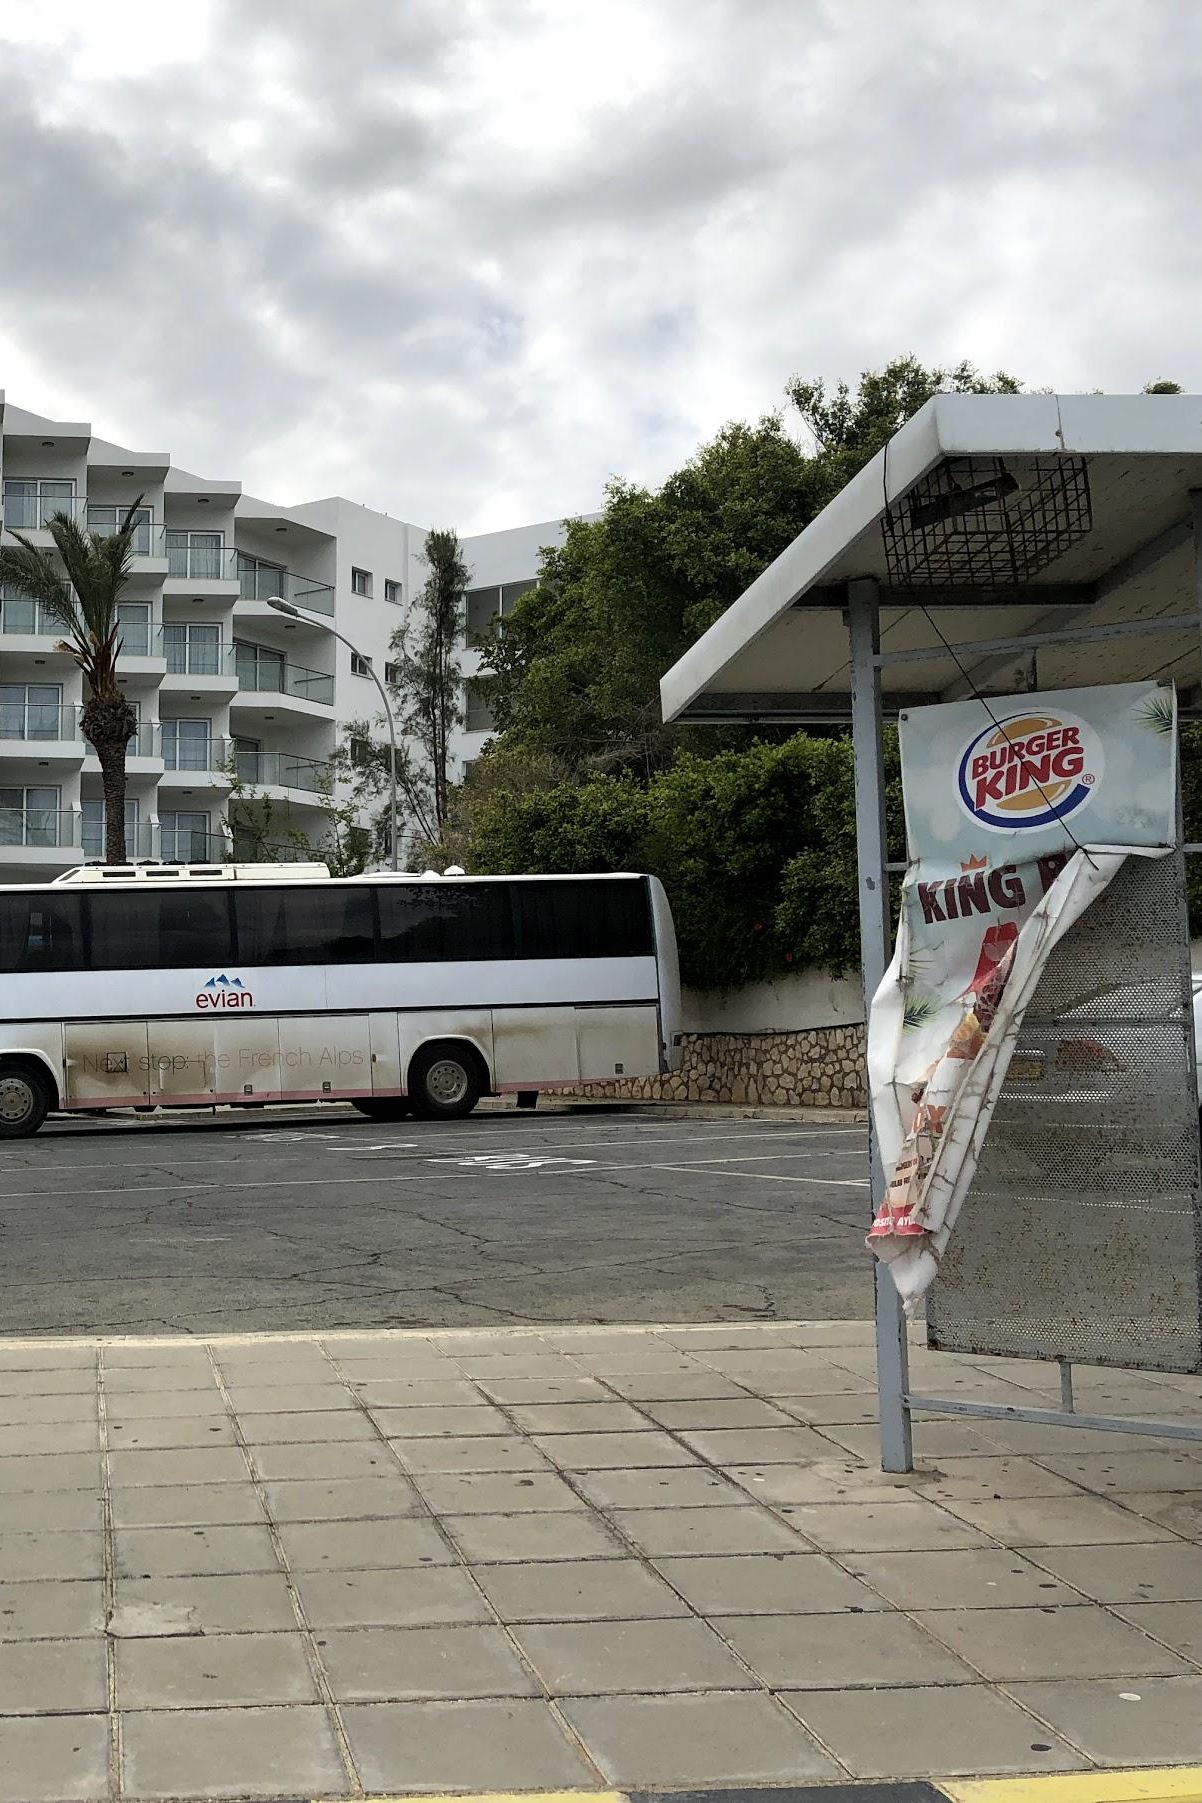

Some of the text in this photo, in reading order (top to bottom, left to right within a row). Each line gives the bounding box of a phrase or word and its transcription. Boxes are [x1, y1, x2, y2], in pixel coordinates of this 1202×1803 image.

[971, 726, 1080, 781] BURGER
[973, 746, 1085, 811] KING
[917, 865, 1026, 924] KING
[196, 989, 253, 1009] evian
[238, 1046, 313, 1069] French
[319, 1045, 364, 1070] Alps
